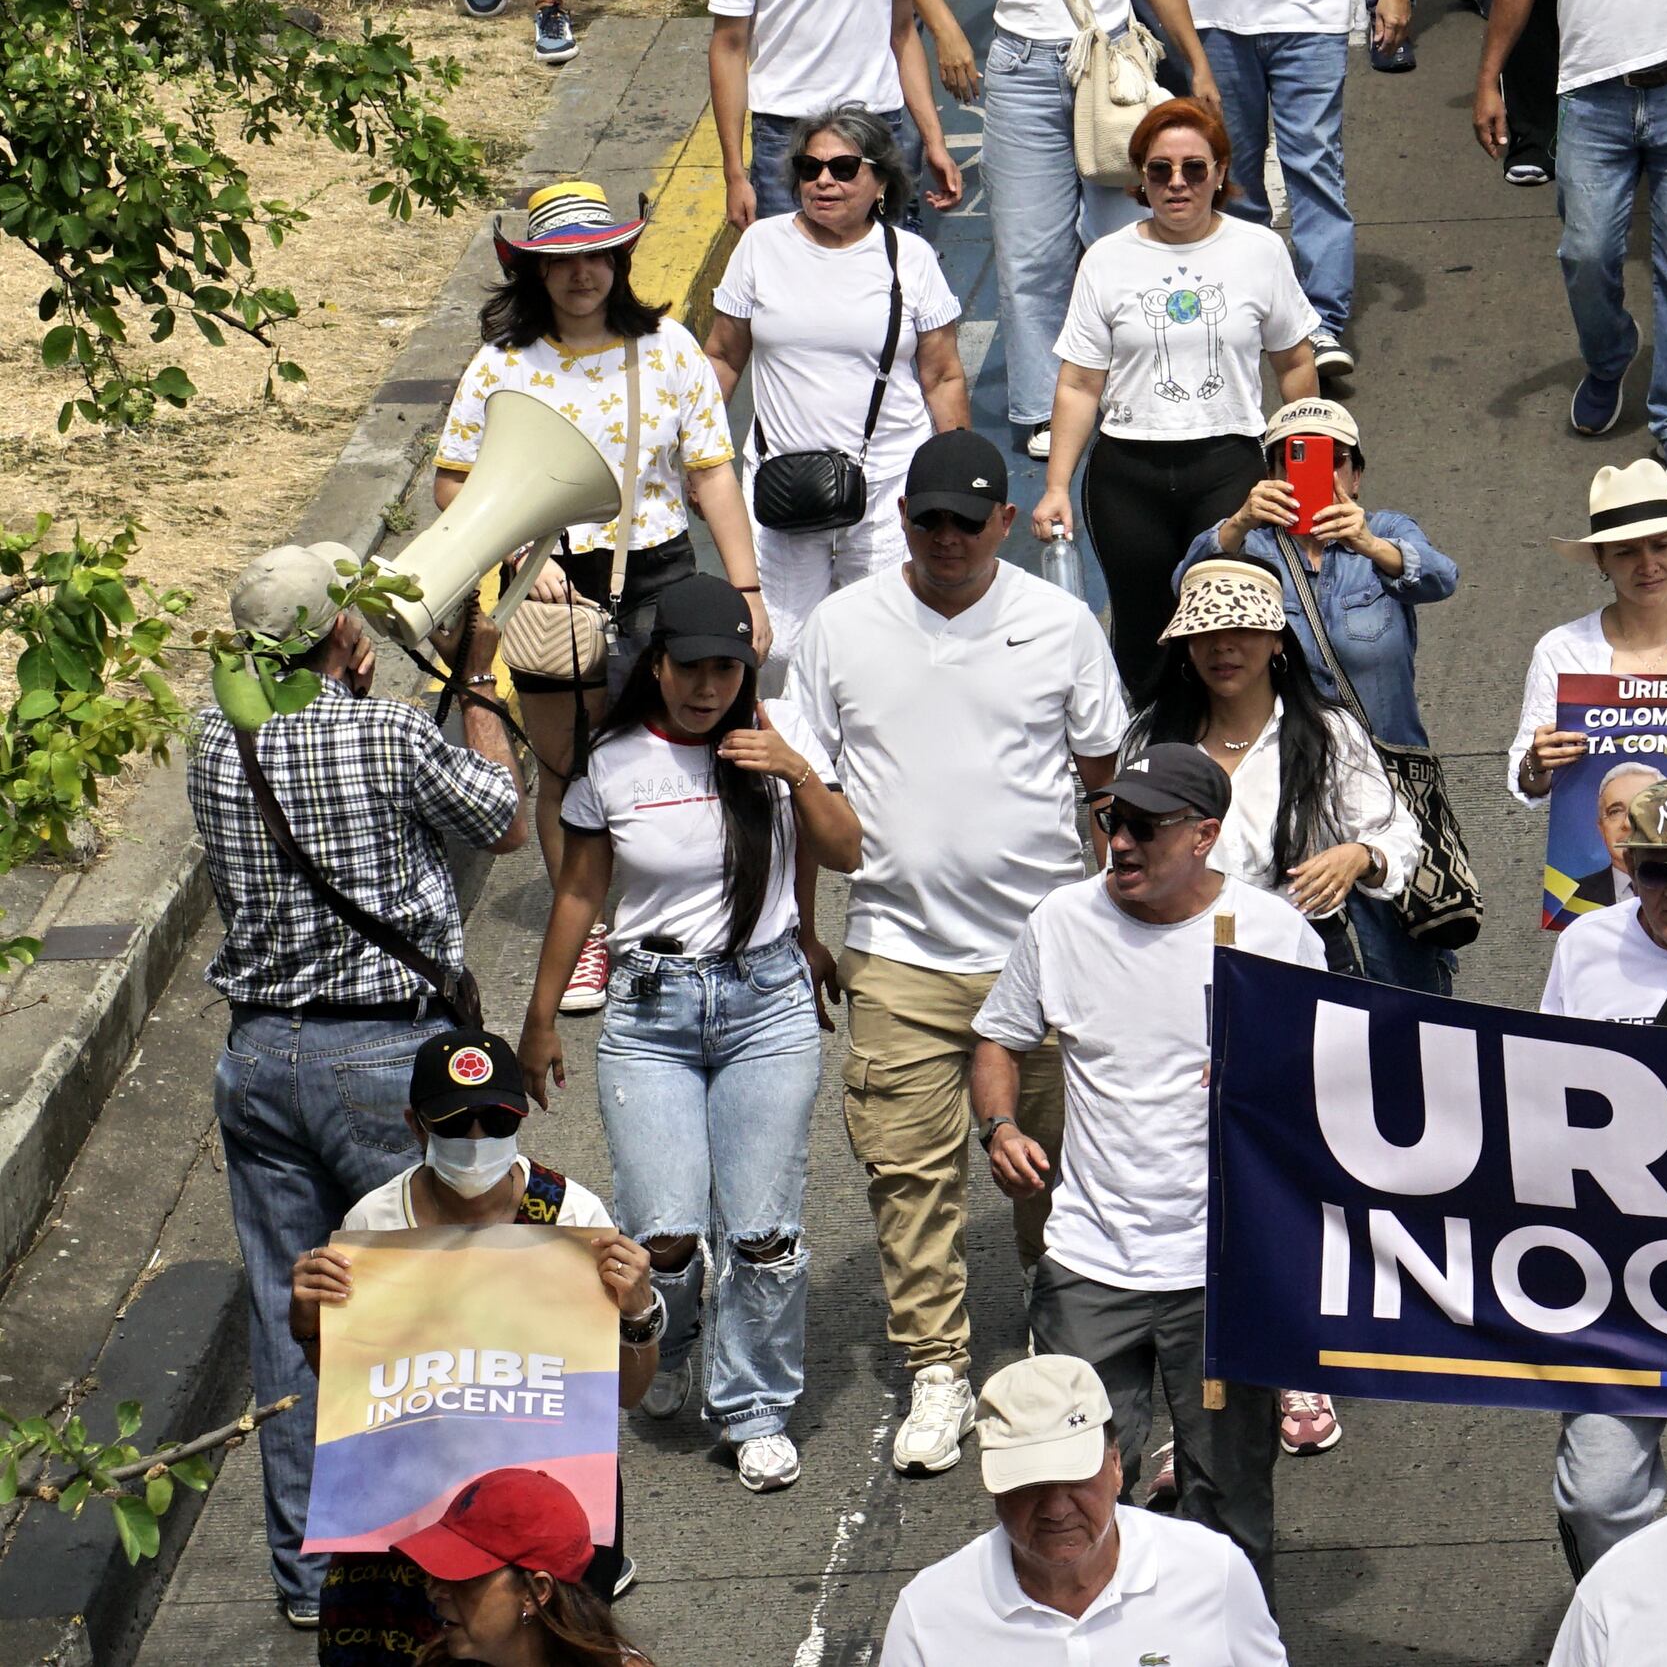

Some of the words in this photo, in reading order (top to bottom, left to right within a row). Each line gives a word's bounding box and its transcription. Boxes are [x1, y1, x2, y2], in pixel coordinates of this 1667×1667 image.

[1281, 406, 1333, 424] CARIBE
[1587, 736, 1619, 756] TA
[368, 1348, 566, 1398] URIBE
[366, 1387, 565, 1428] INOCENTE
